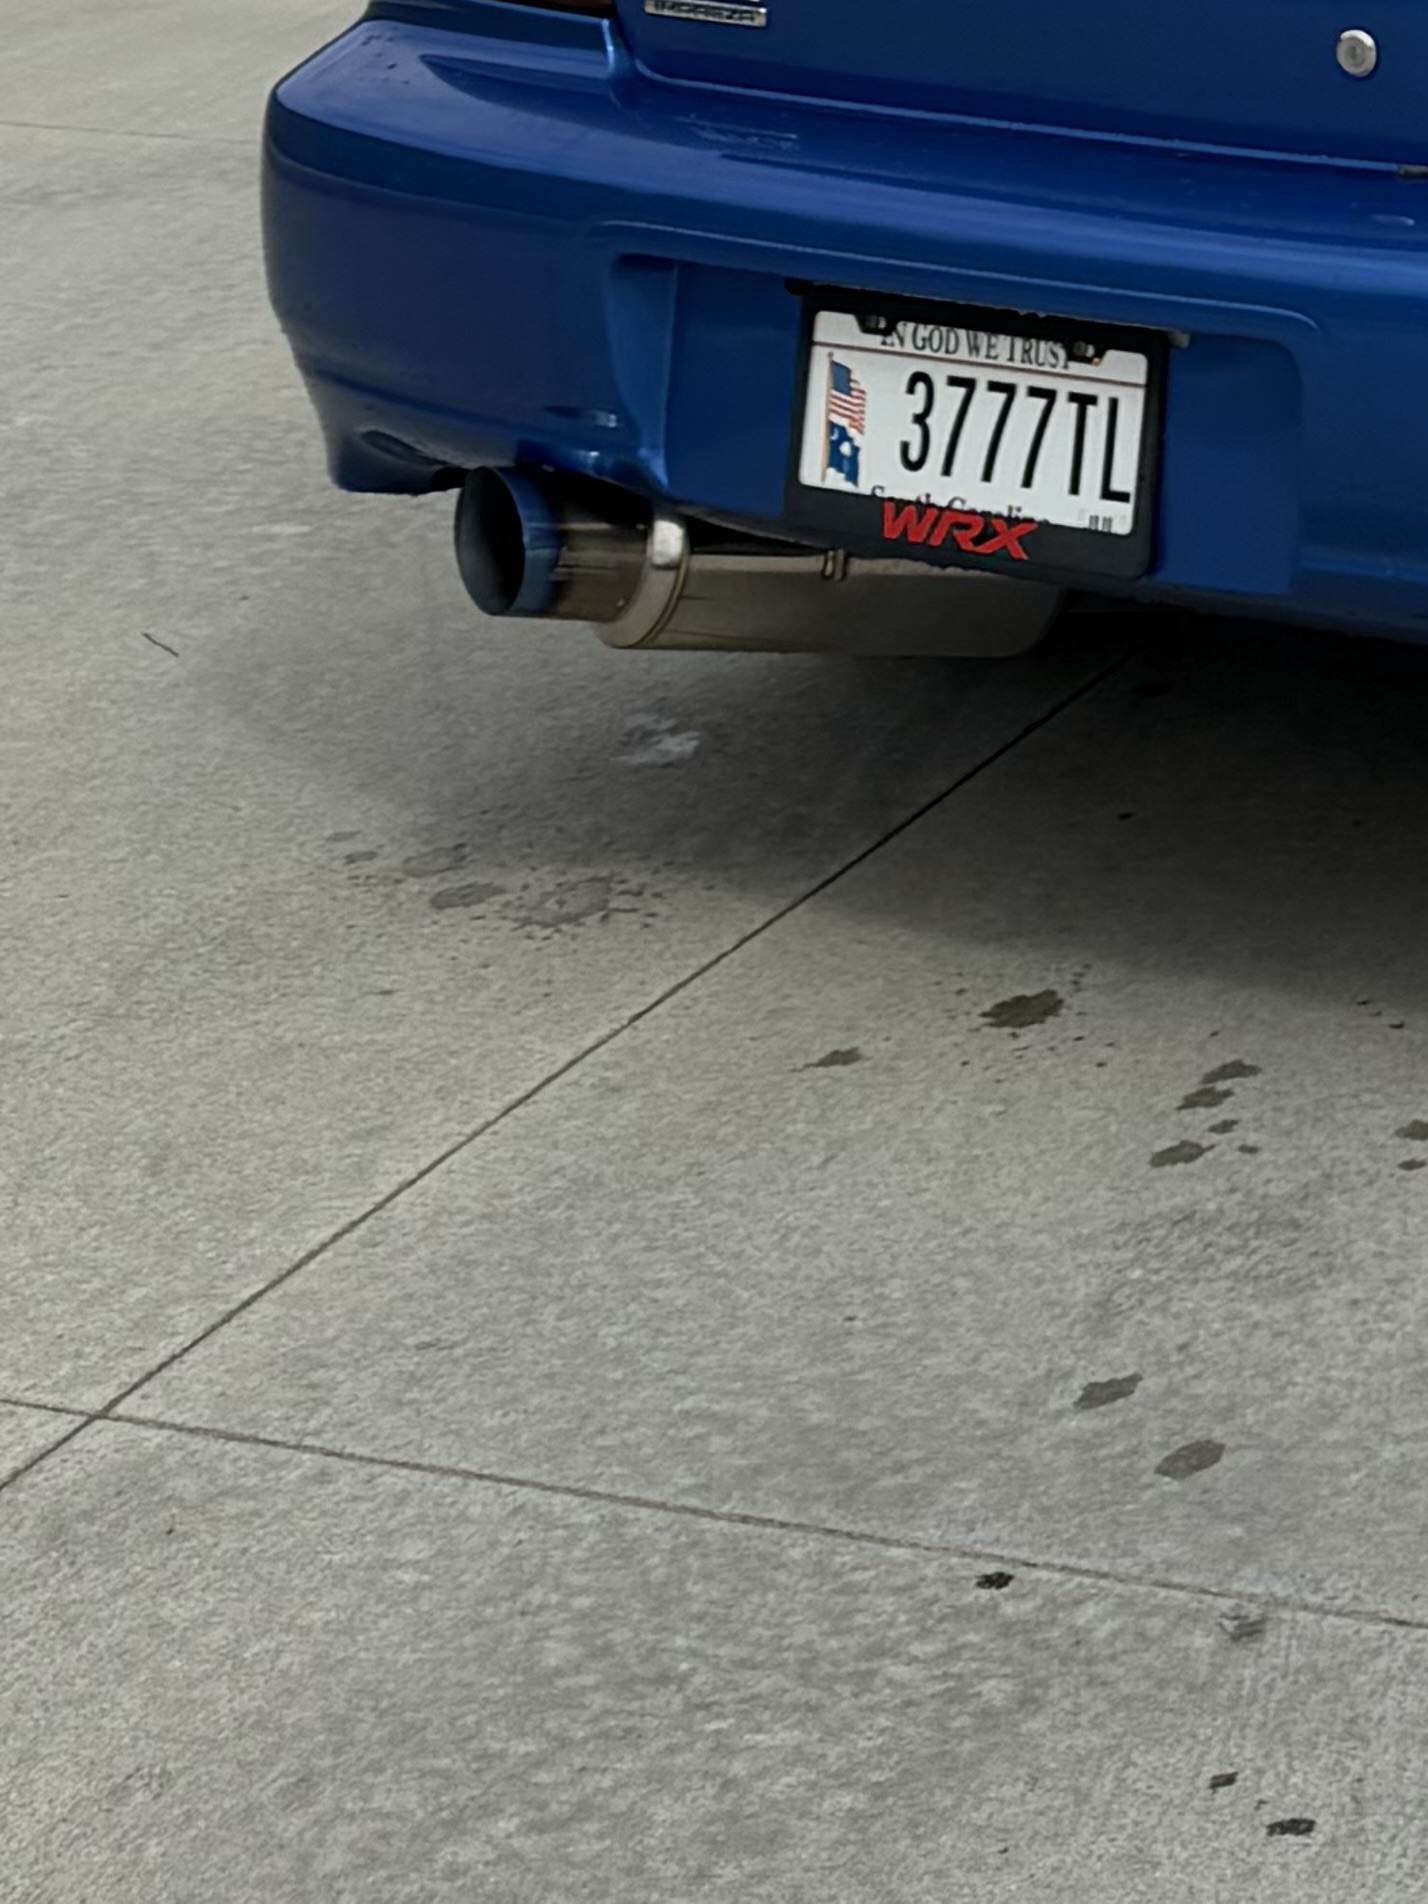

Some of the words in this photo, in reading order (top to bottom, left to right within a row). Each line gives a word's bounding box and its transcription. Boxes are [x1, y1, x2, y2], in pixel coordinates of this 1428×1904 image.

[912, 324, 960, 355] GOD
[966, 329, 999, 361] WE
[900, 371, 1130, 503] 3777TL
[882, 500, 1039, 560] WRX
